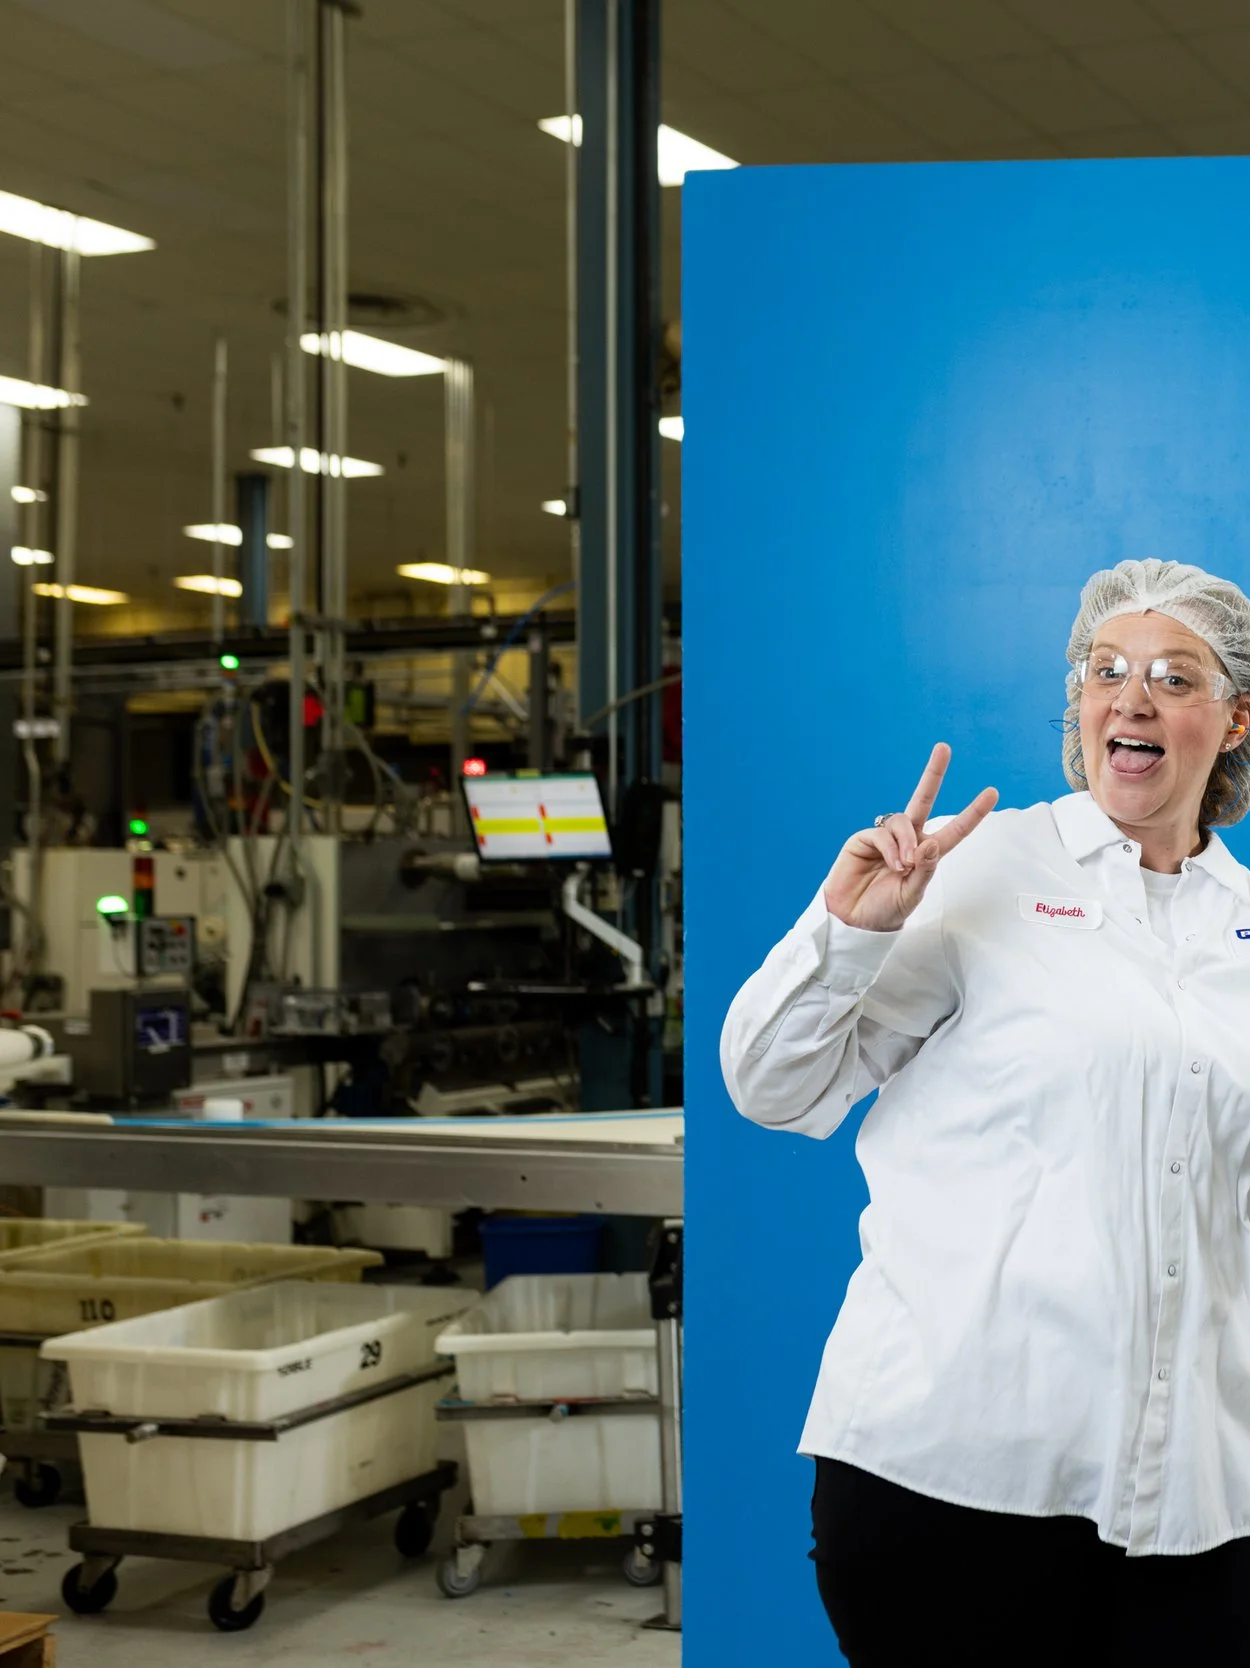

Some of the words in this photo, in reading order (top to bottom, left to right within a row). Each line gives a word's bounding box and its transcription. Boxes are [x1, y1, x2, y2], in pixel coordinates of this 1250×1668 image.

[1035, 902, 1086, 918] Elizabeth
[79, 1297, 116, 1322] 110
[360, 1339, 382, 1371] 29
